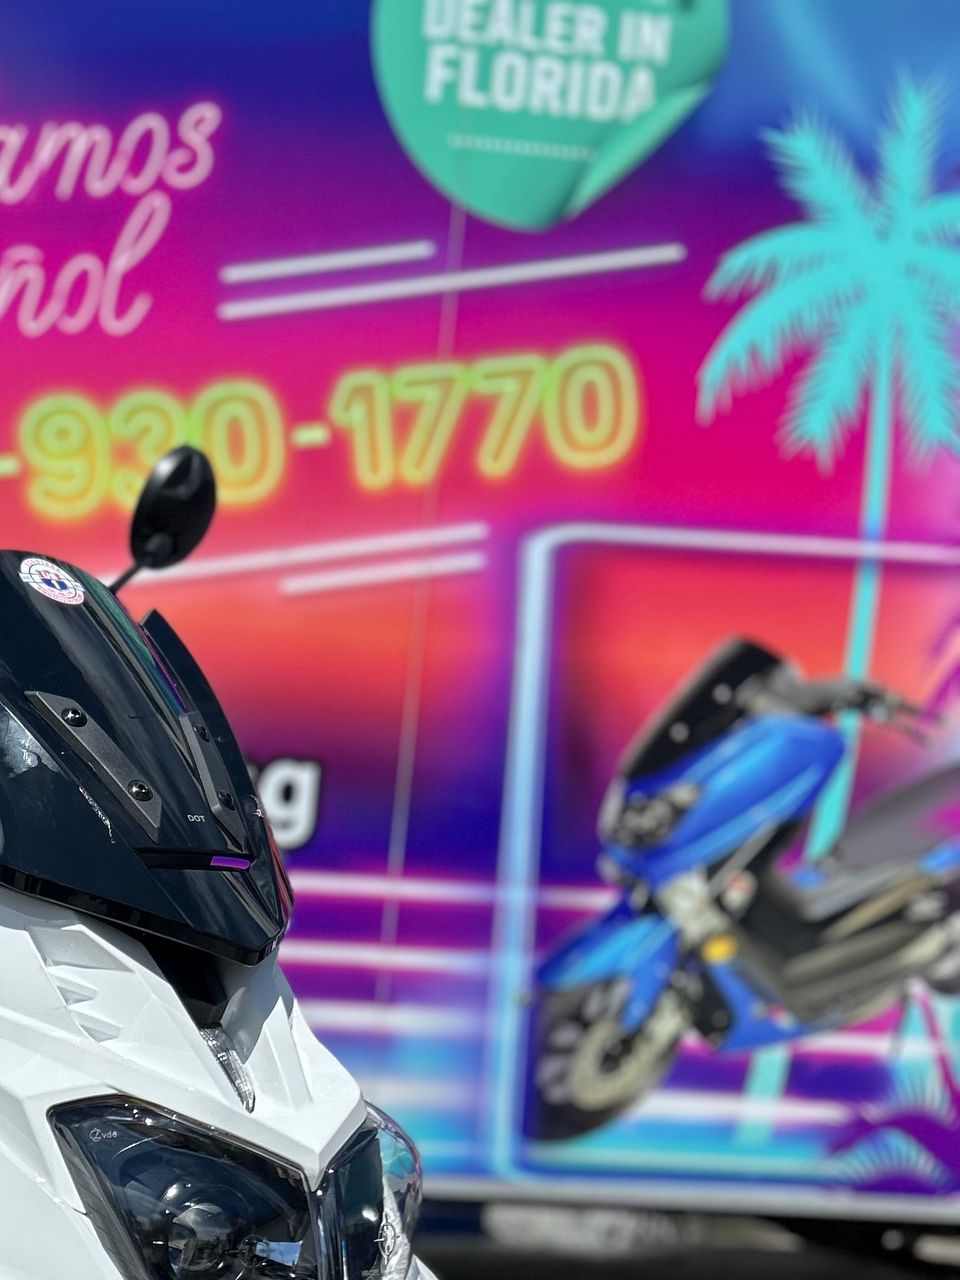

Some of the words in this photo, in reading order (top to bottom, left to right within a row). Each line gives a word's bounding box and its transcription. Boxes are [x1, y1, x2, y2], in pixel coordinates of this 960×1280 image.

[422, 0, 607, 57] DEALER
[618, 10, 672, 66] IN
[425, 42, 657, 124] FLORIDA
[187, 814, 206, 823] DOT
